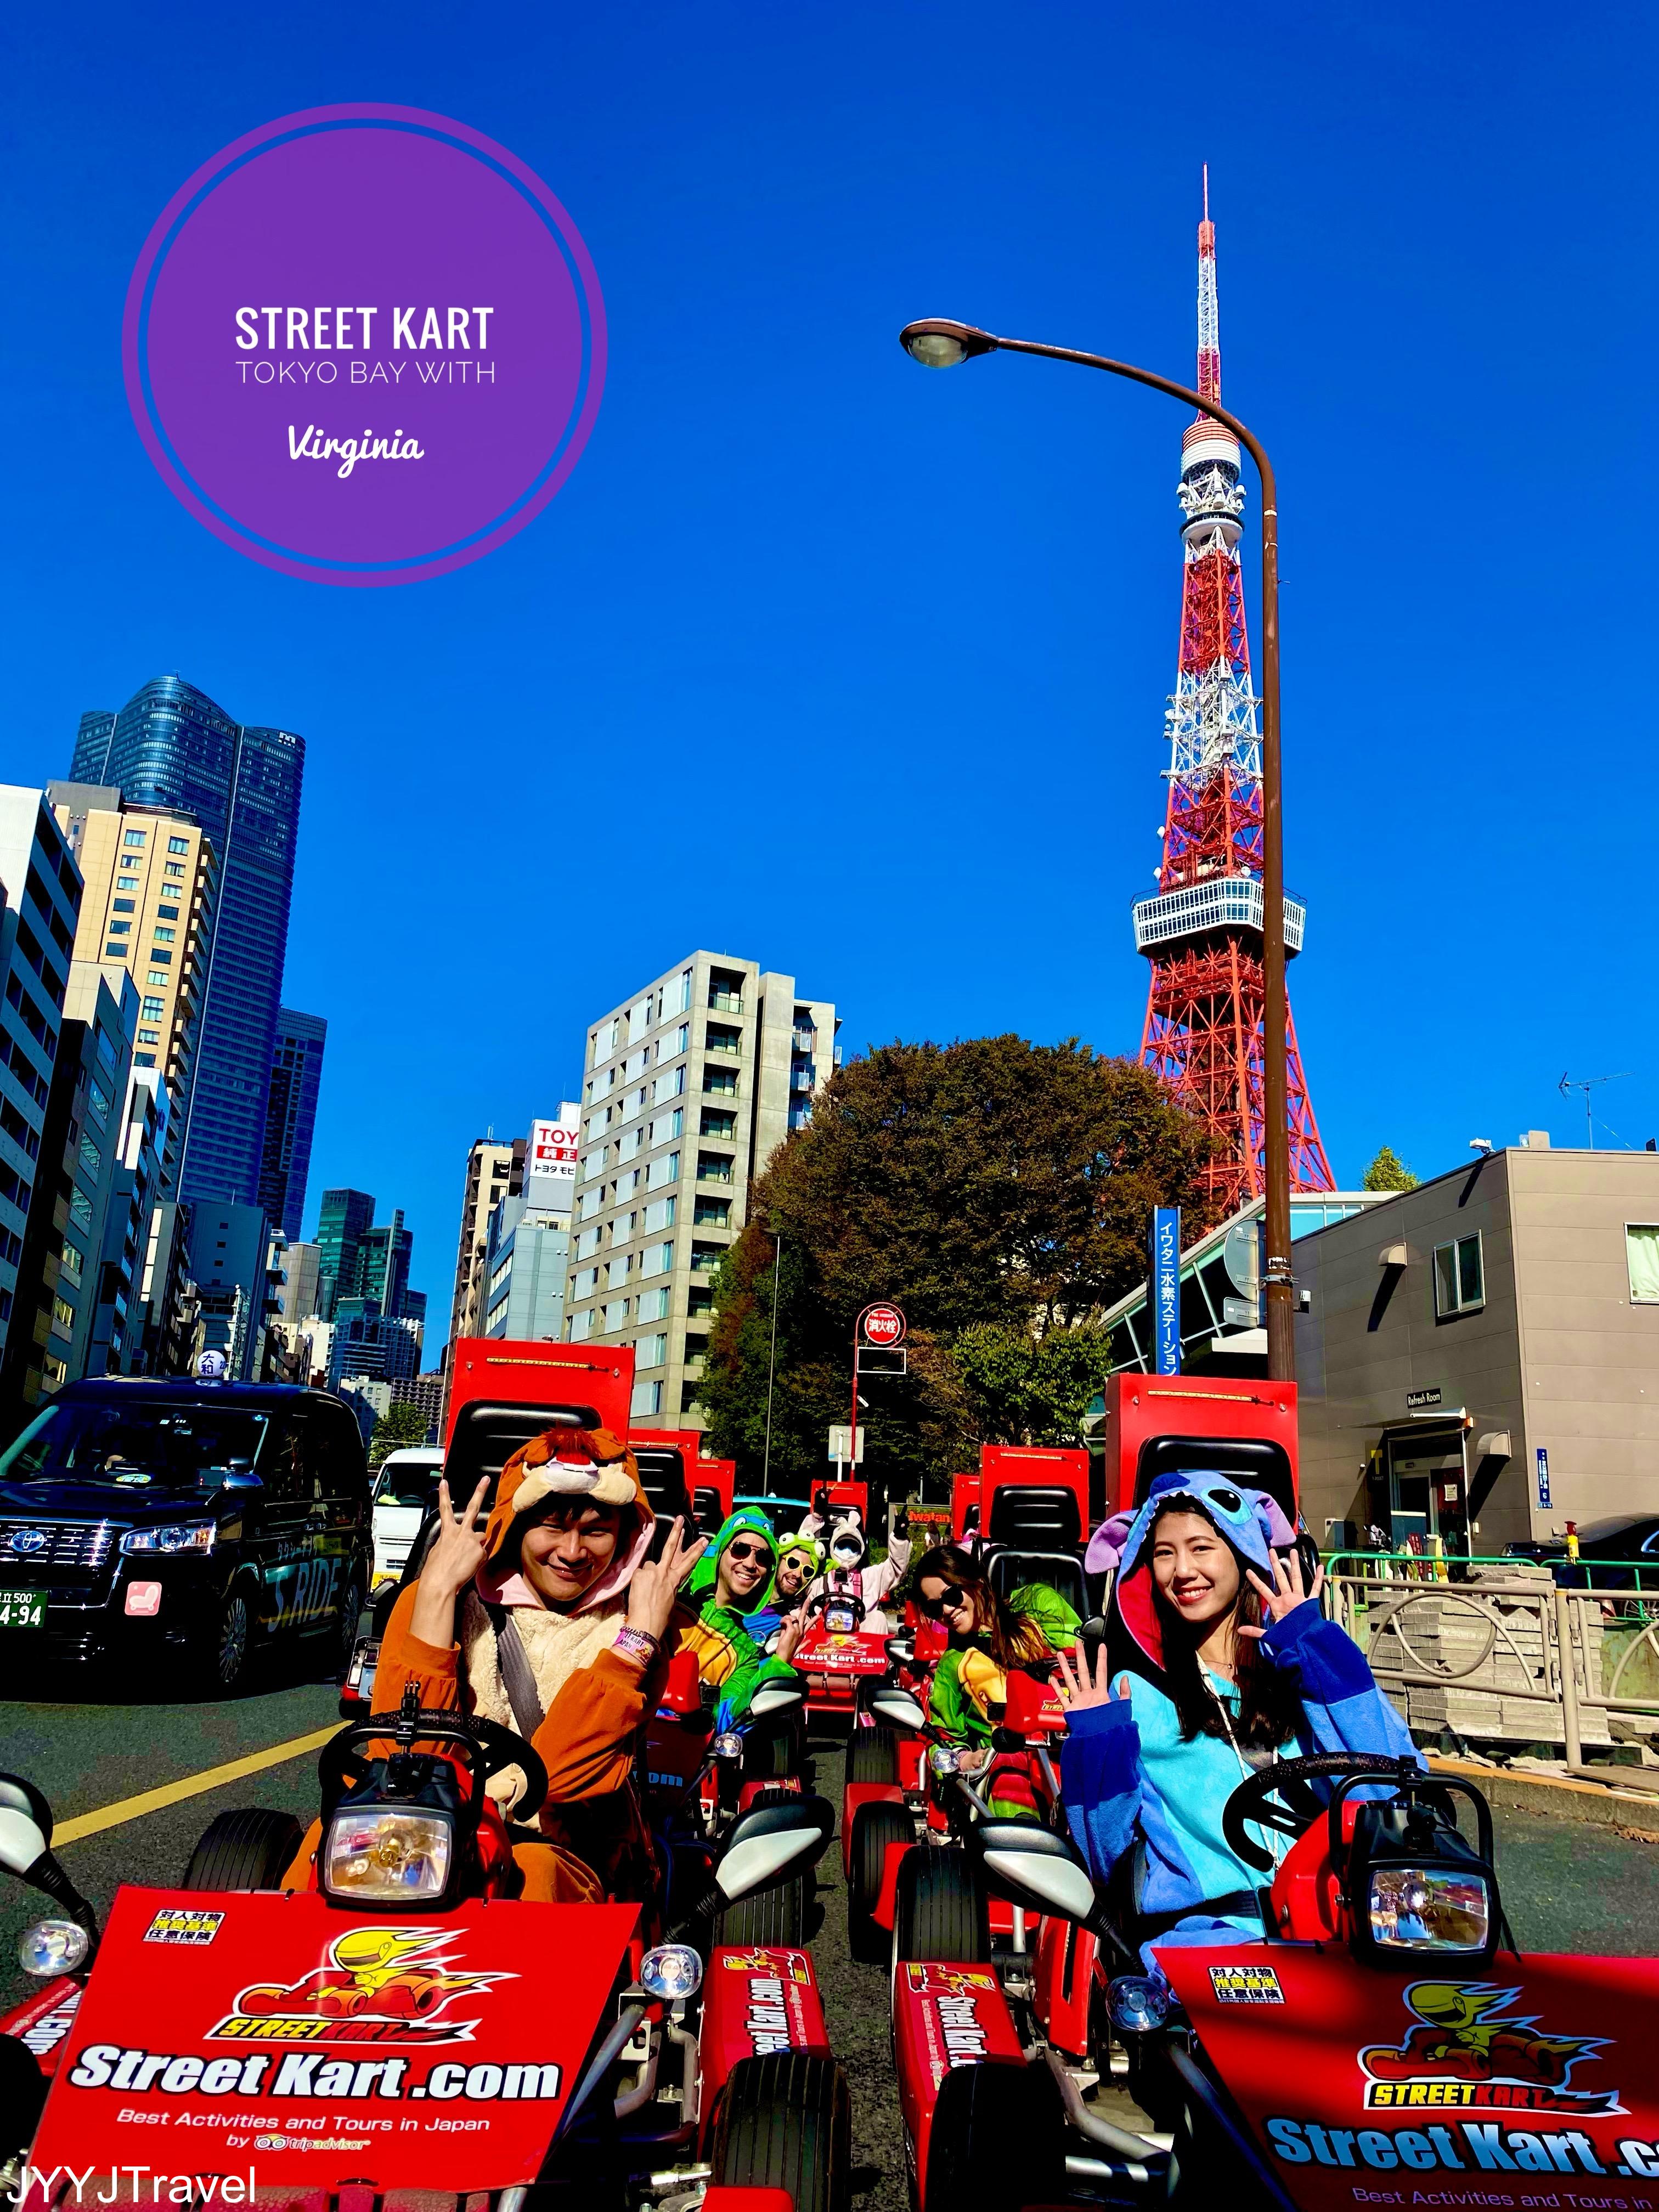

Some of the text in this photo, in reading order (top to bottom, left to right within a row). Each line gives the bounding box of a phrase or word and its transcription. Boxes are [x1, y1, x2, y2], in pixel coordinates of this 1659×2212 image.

[539, 1128, 579, 1145] TOY
[543, 1147, 575, 1160] 純正
[1160, 1222, 1177, 1376] イワタニ水素ステーション
[868, 1319, 897, 1334] 消火栓
[201, 1353, 215, 1375] 大和
[1408, 1392, 1441, 1406] Refresh Room
[14, 1593, 32, 1604] 500
[630, 1635, 645, 1647] KART
[830, 1654, 855, 1663] Kart
[160, 1911, 222, 1921] 対人対物
[1211, 1968, 1273, 1977] 対人対物
[750, 1978, 784, 2005] .com
[747, 2005, 788, 2031] Kart
[937, 1996, 980, 2028] Street
[944, 2029, 988, 2055] Kart
[71, 2045, 560, 2098] Street Kart .com
[116, 2108, 490, 2133] Best Activities and Tours in Japan
[225, 2134, 250, 2148] by
[1267, 2118, 1465, 2170] Street
[1461, 2123, 1607, 2174] Kart
[1352, 2187, 1654, 2210] Best Activities and Tours in
